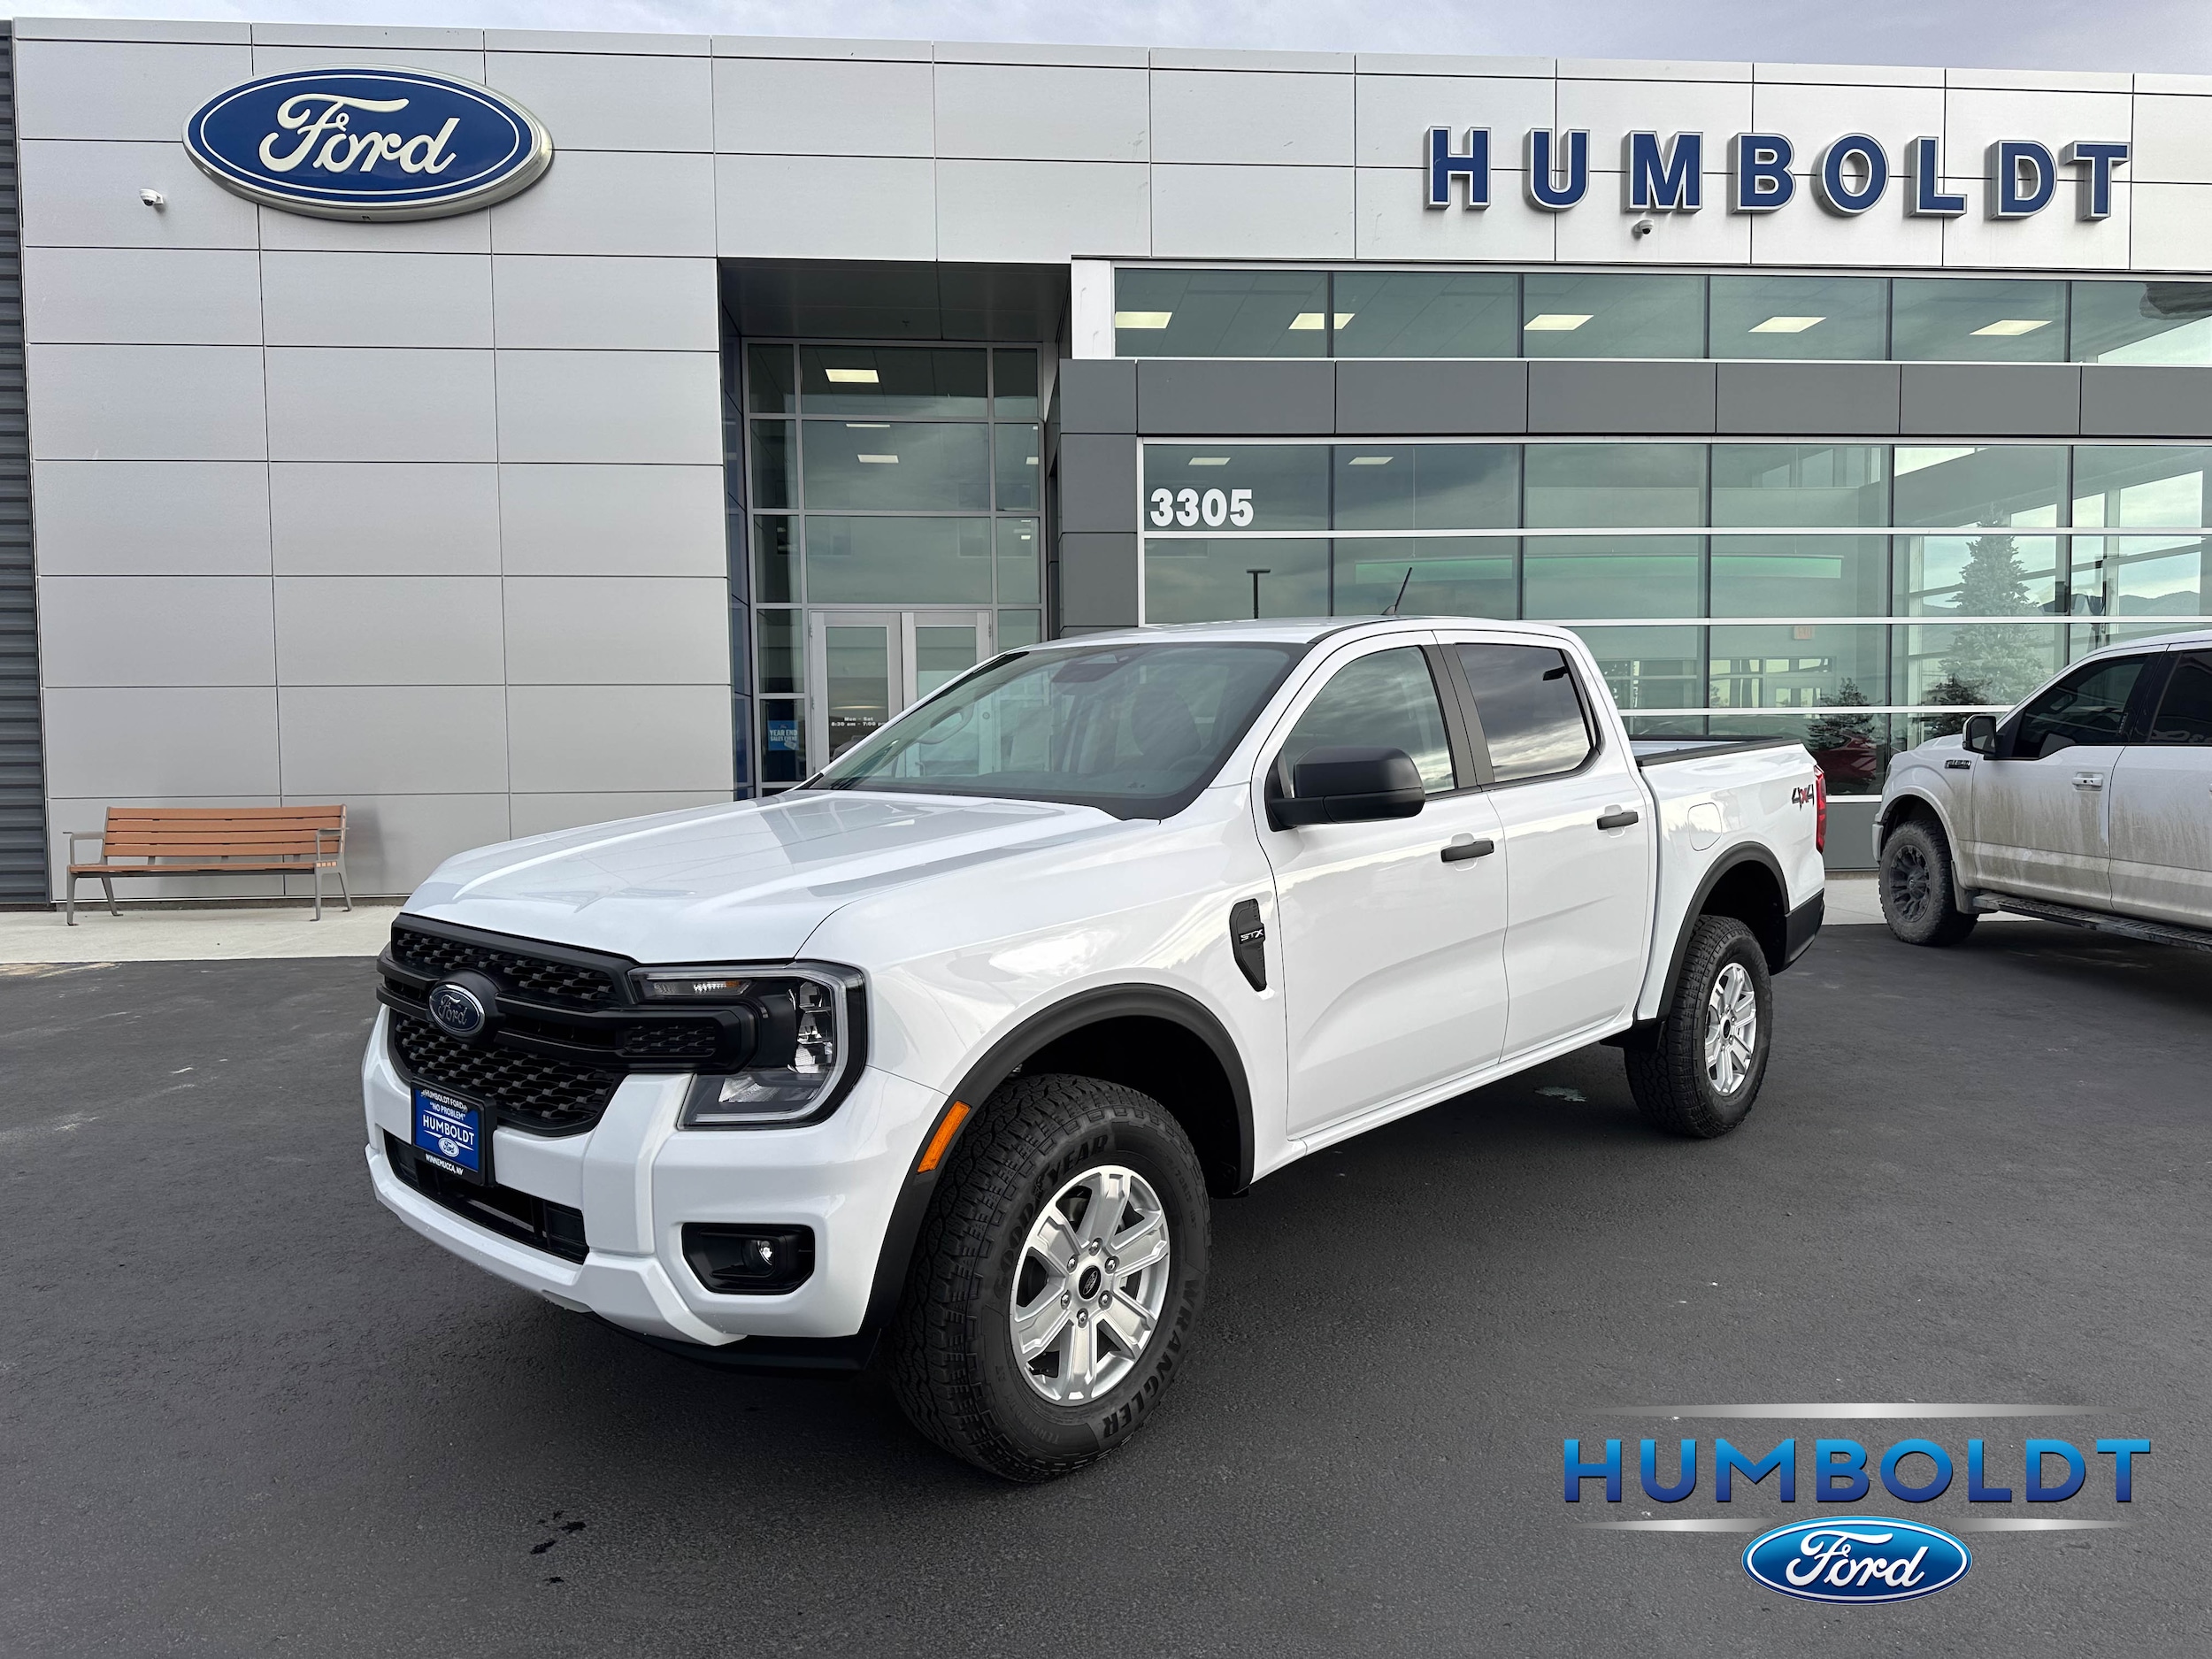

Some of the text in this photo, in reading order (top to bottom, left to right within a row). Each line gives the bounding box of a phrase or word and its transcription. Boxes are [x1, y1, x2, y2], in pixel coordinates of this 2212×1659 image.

[259, 93, 461, 175] Ford
[1425, 125, 2131, 222] HUMBOLDT
[1149, 488, 1255, 527] 3305
[1240, 929, 1264, 942] STX
[437, 994, 468, 1025] Ford
[425, 1088, 464, 1110] HUMBOLDT FORD
[423, 1114, 475, 1145] HUMBOLDT
[456, 1167, 465, 1176] NV
[1102, 1279, 1198, 1438] WRANGLER
